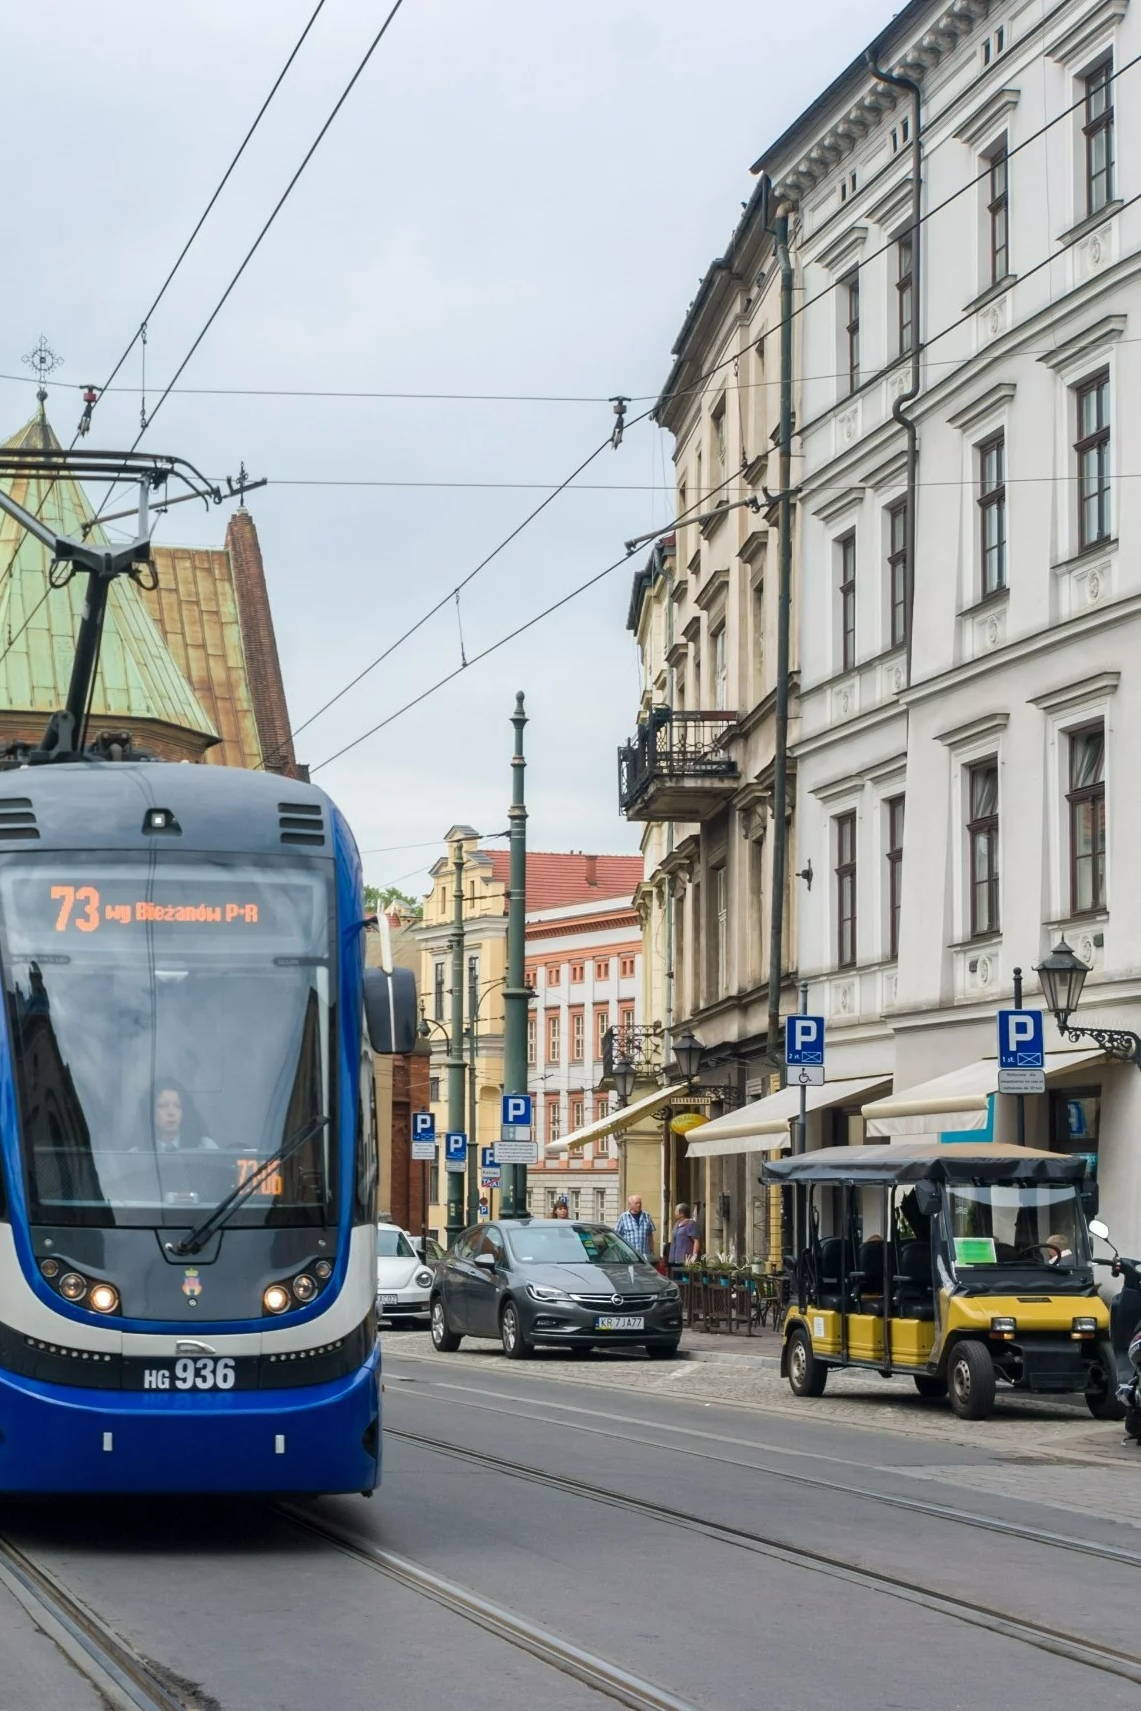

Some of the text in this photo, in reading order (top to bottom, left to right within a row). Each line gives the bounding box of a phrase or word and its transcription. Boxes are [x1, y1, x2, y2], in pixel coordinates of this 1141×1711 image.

[50, 886, 100, 932] 73
[795, 1020, 817, 1050] P
[1008, 1015, 1034, 1051] P
[508, 1099, 525, 1121] P
[417, 1114, 431, 1133] P
[450, 1136, 462, 1152] P
[601, 1317, 642, 1327] KR 7JA77
[144, 1358, 236, 1389] HG 936
